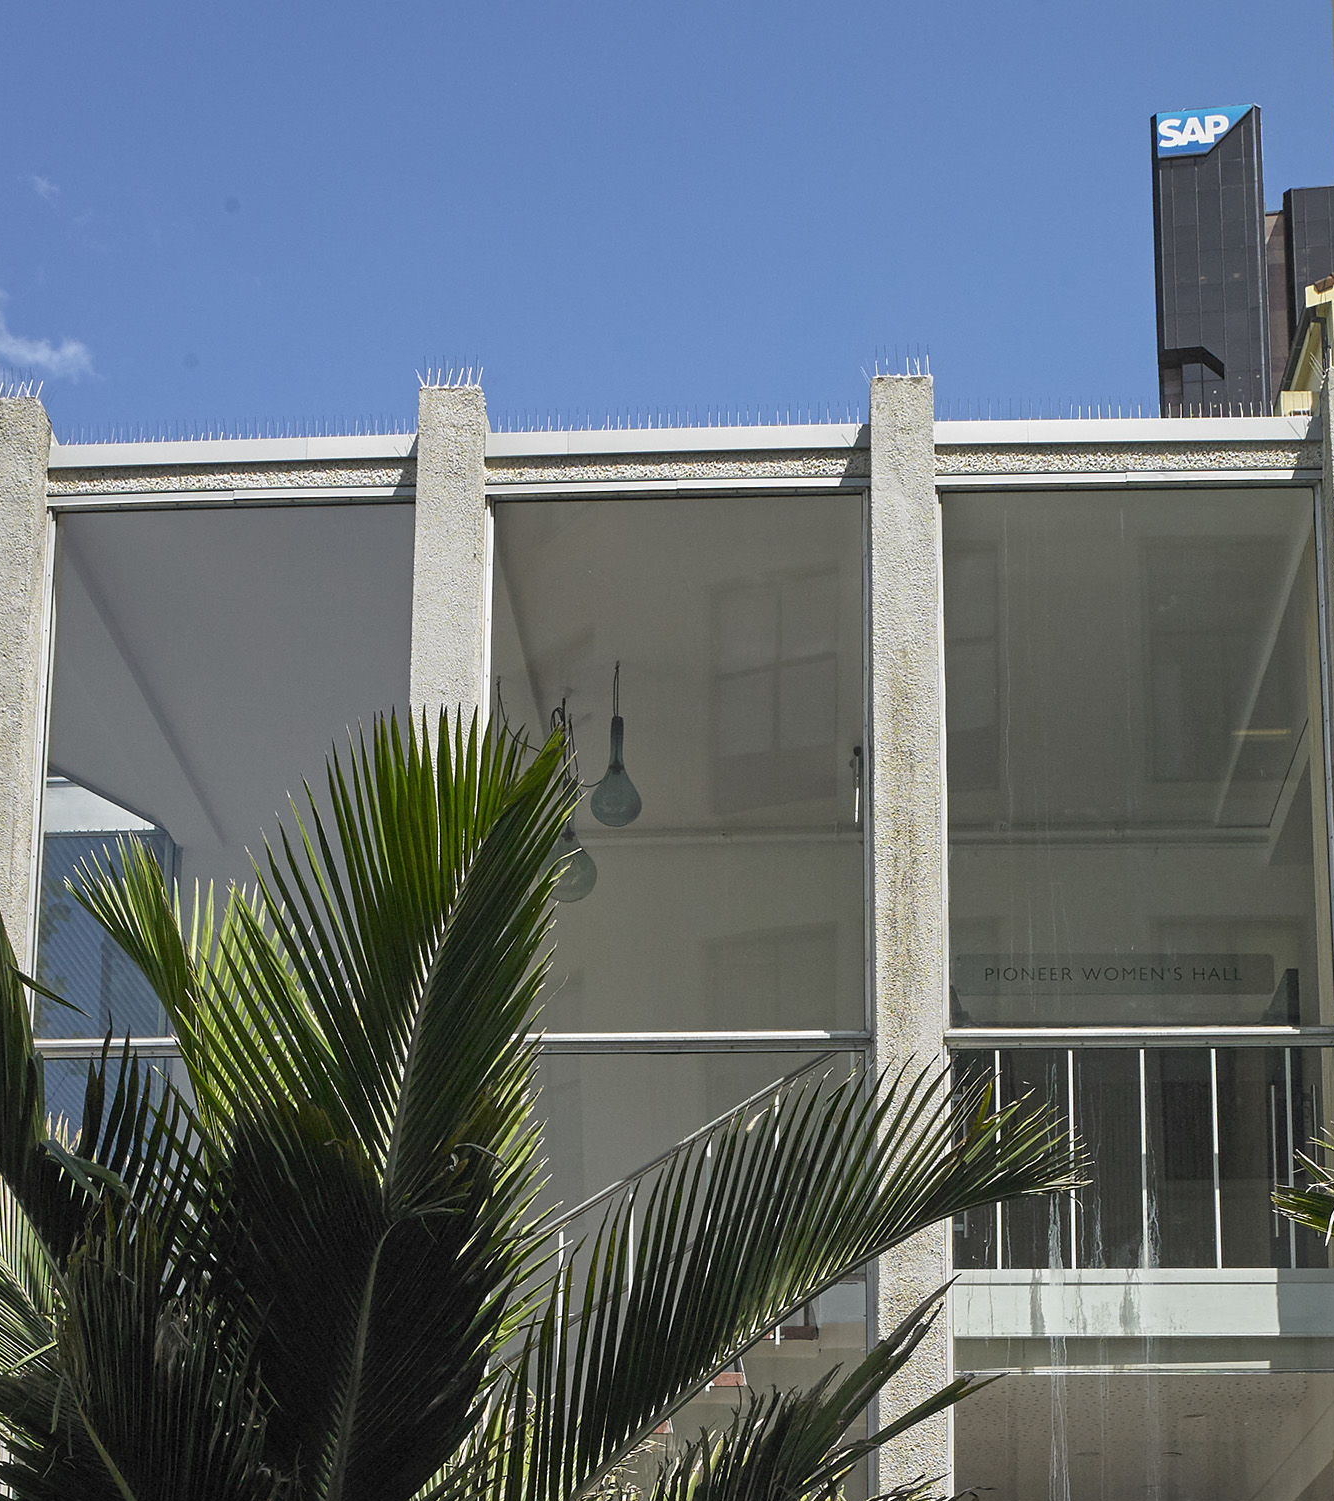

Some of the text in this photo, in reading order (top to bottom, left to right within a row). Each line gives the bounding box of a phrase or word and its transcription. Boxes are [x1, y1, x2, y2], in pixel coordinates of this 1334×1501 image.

[1157, 114, 1230, 148] SAP
[984, 967, 1243, 981] PIONEER WOMEN'S HALL
